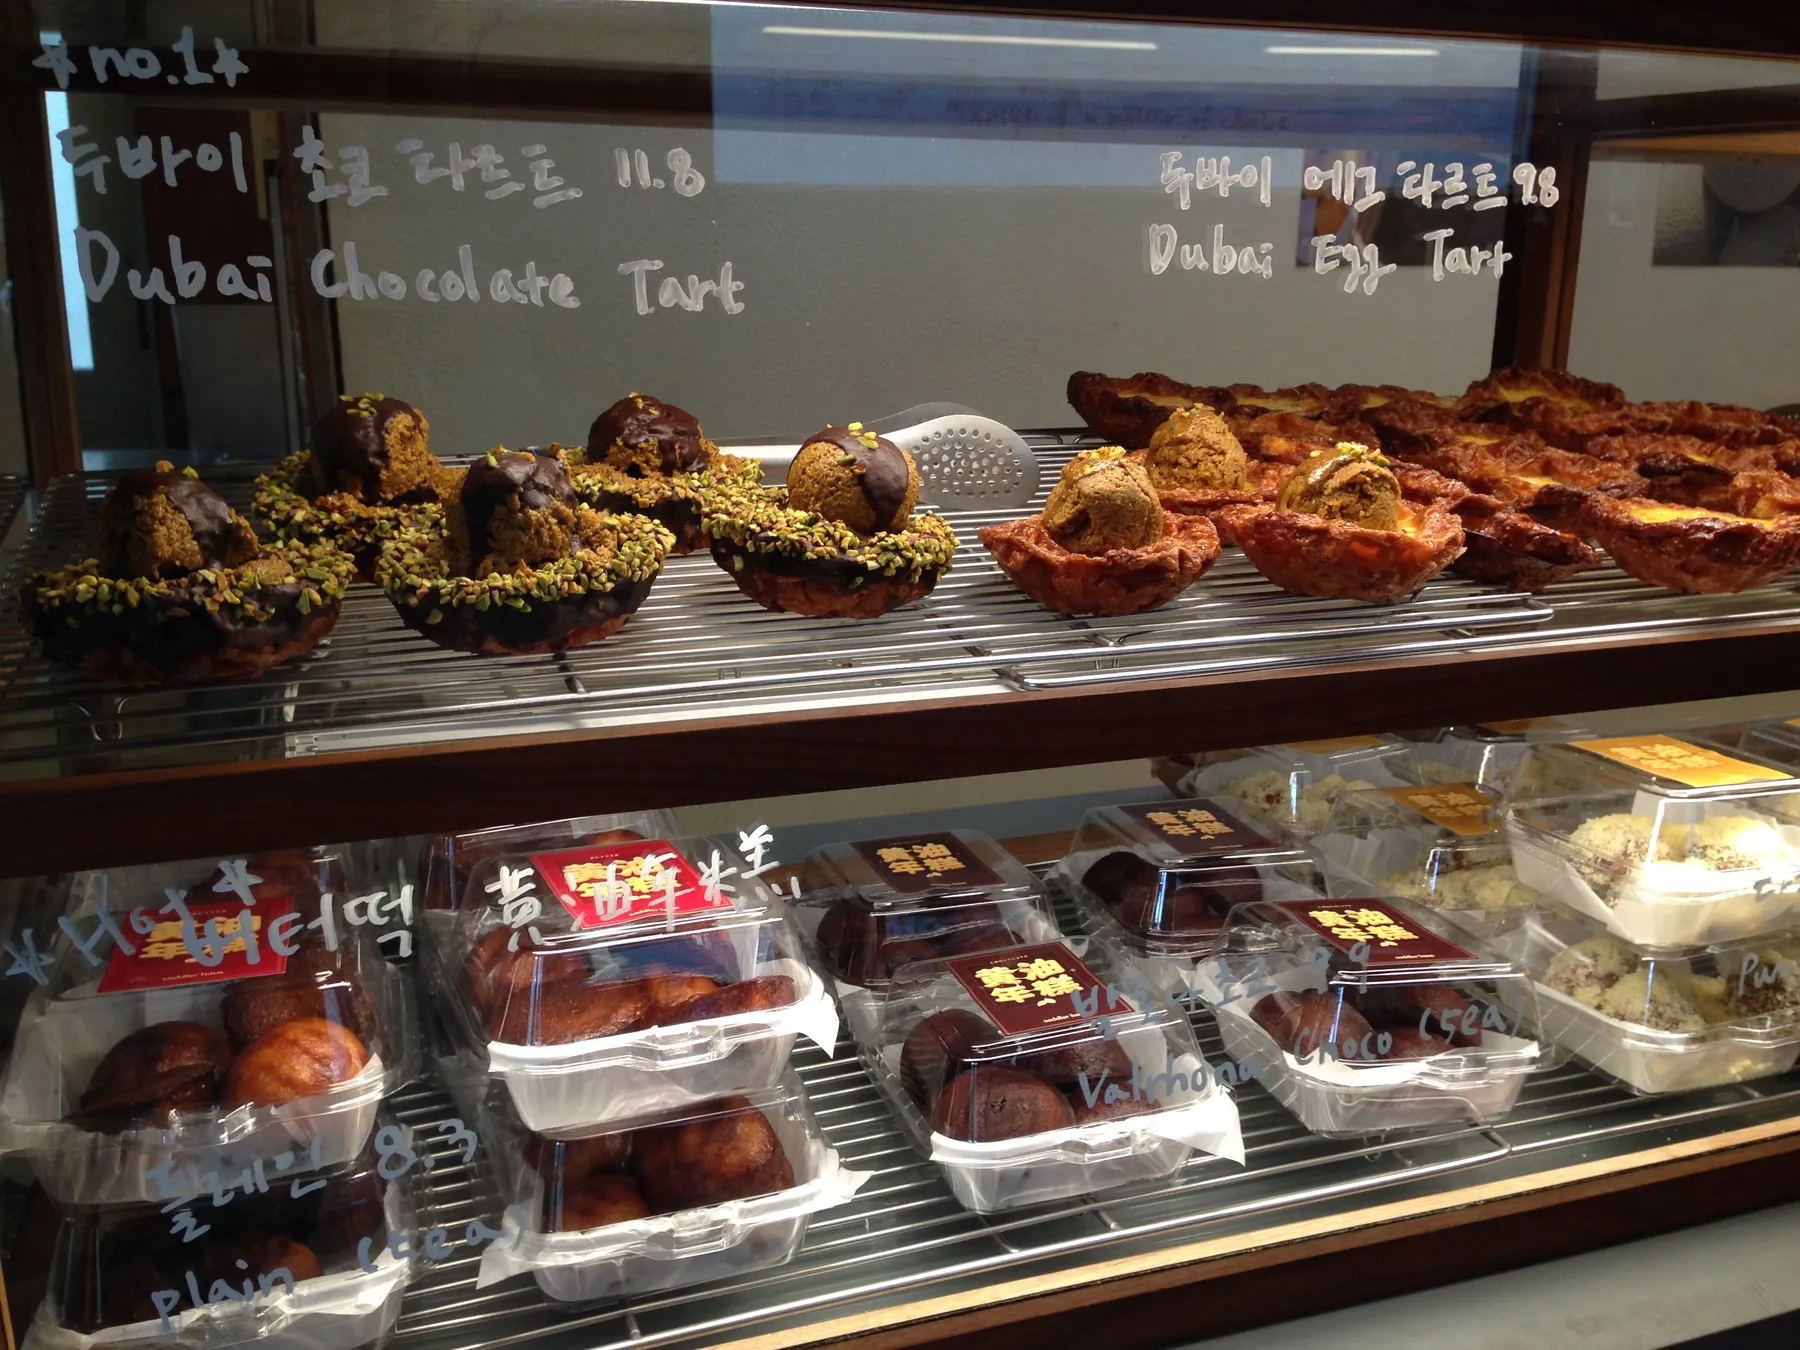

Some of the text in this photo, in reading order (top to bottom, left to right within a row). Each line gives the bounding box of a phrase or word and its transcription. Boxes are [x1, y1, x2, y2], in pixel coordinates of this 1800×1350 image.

[56, 125, 706, 209] 두바이 초코 타르트 11.8
[1160, 151, 1559, 212] 두바이 에그 타르트 9.8
[74, 228, 746, 314] Dubai Chocolate Tart
[1149, 223, 1513, 295] Dubai Egg Tart
[181, 884, 414, 967] 버터떡
[1078, 993, 1524, 1109] Valrhona Choco (5ea)
[143, 1118, 478, 1243] 플레인 8.3
